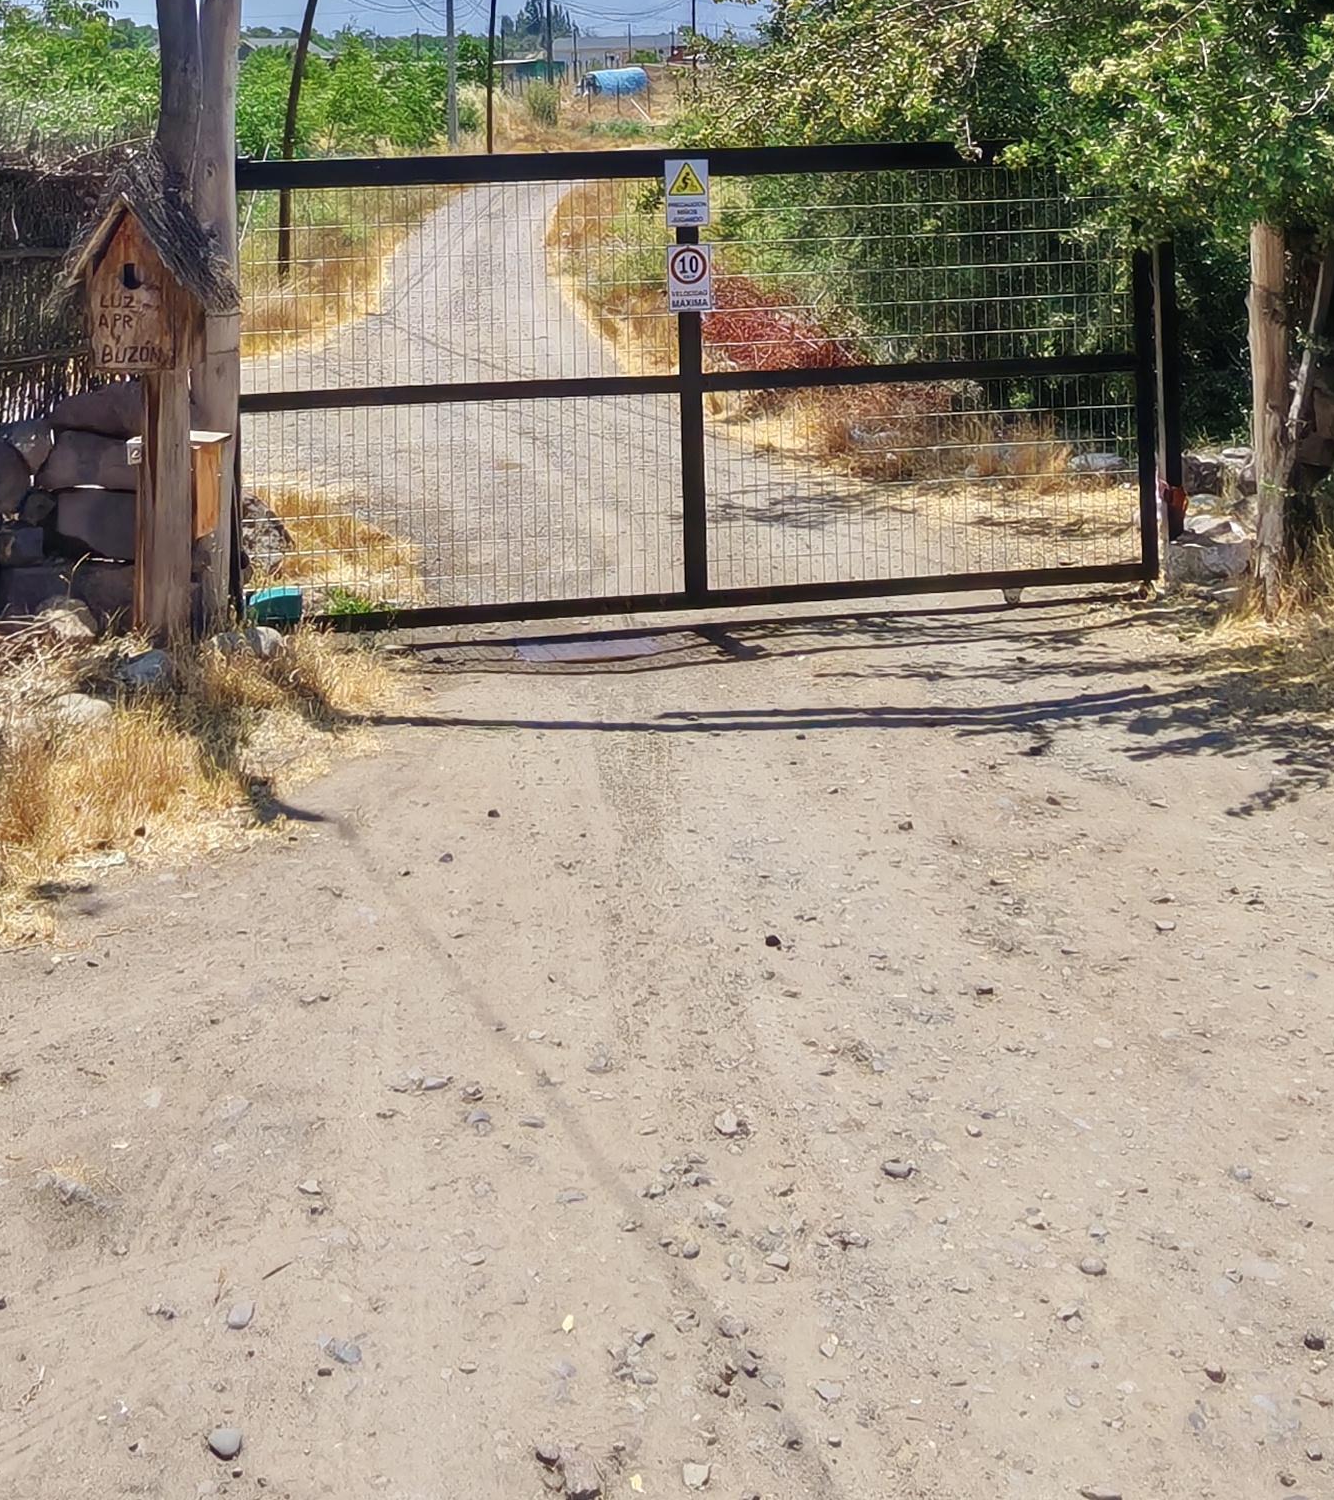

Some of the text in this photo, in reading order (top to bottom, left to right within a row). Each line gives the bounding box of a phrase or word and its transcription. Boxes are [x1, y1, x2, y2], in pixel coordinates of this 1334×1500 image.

[679, 255, 698, 274] 10
[100, 293, 136, 308] LUZ
[101, 340, 163, 364] BUZÓN
